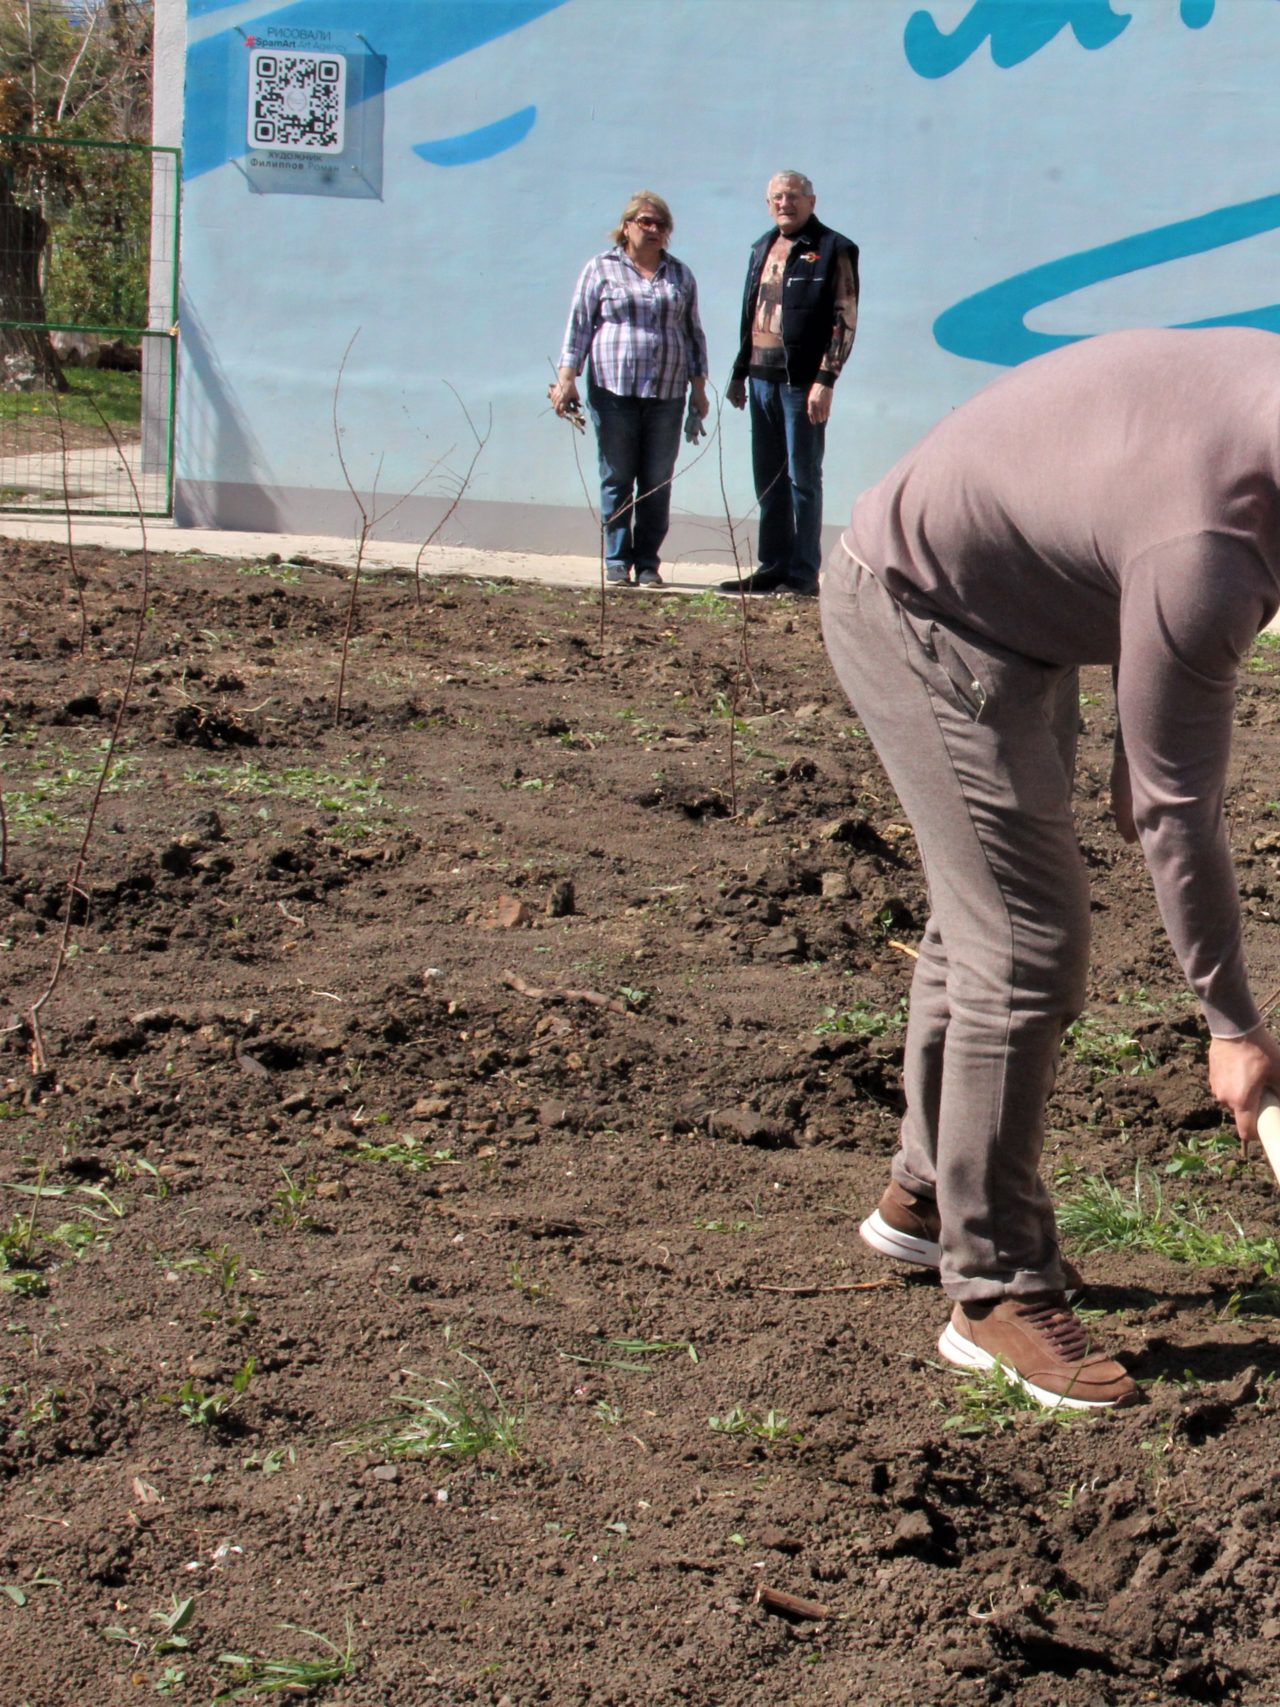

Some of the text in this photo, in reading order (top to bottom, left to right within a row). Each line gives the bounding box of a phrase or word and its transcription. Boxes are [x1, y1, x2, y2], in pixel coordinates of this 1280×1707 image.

[267, 26, 331, 41] РИСОВАЛИ
[245, 35, 296, 48] #SpamArt
[250, 158, 304, 170] Филиппов
